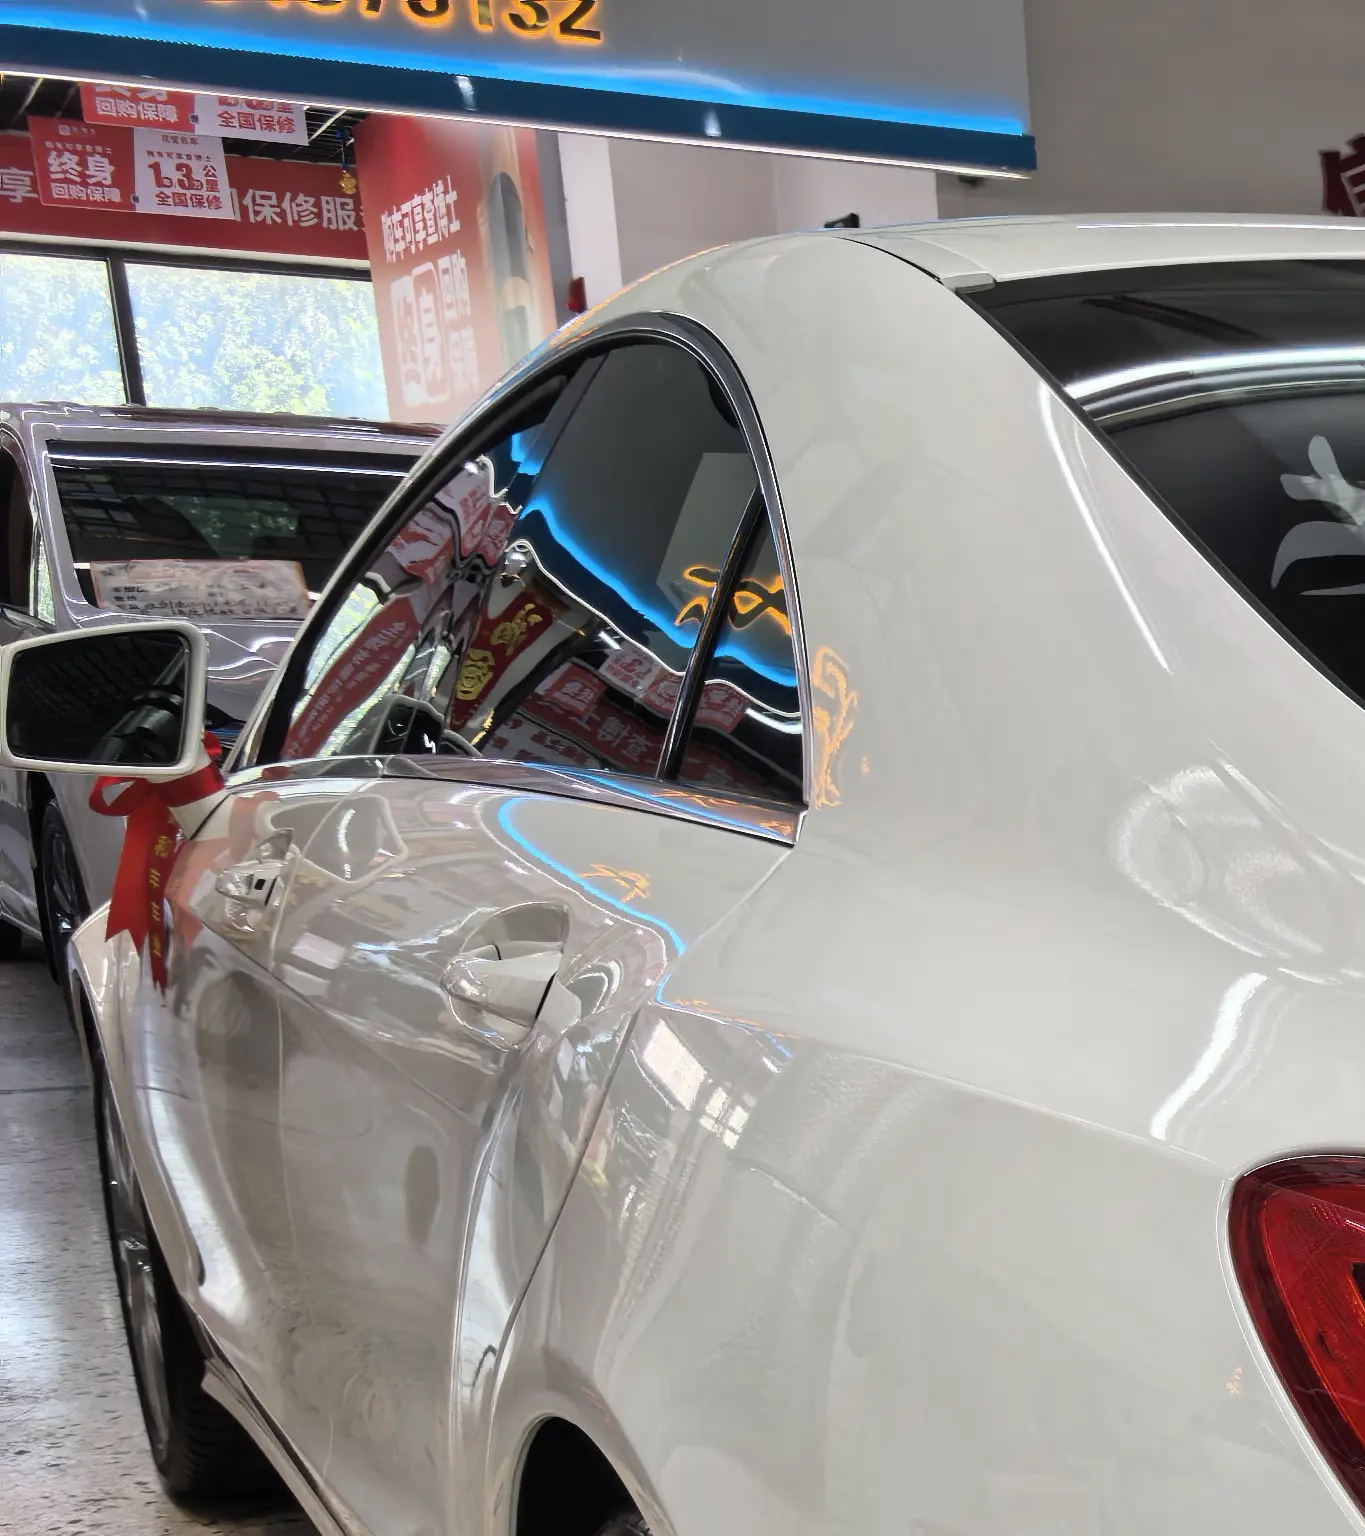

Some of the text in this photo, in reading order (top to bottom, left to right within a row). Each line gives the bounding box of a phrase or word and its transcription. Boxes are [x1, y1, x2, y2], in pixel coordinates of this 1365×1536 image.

[95, 97, 178, 123] 回购保障
[217, 109, 297, 134] 全国保修
[48, 150, 116, 186] 终身
[51, 182, 122, 203] 回购保障
[155, 190, 224, 210] 全国保修
[231, 188, 365, 232] 保修服
